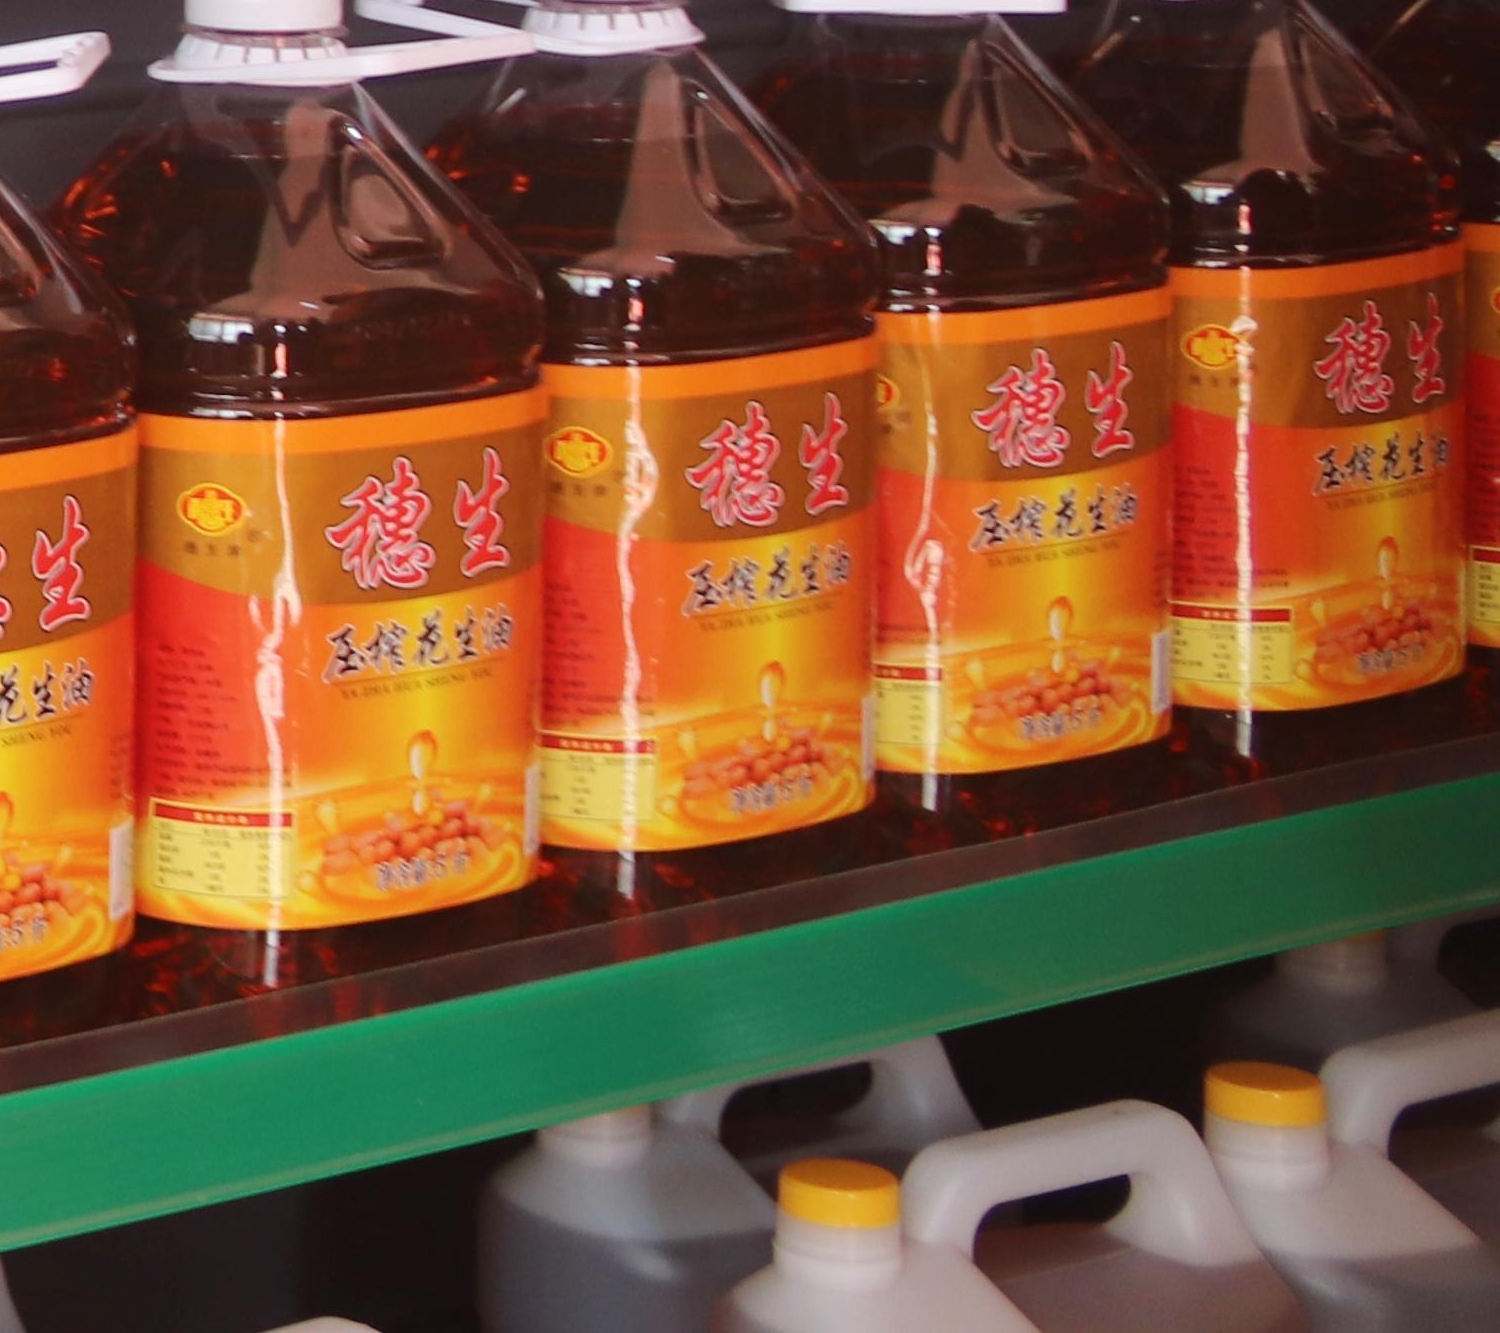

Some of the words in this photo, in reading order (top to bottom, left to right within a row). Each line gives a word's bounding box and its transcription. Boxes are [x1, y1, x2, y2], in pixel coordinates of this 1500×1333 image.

[1314, 292, 1445, 414] 穗生
[972, 341, 1135, 468] 穗生
[684, 391, 849, 527] 穗生
[1312, 432, 1450, 497] 压榨花生油
[325, 447, 511, 590] 穗生
[968, 483, 1138, 551] 压榨花生油
[682, 540, 851, 617] 压榨花生油
[321, 603, 515, 682] 压榨花生油
